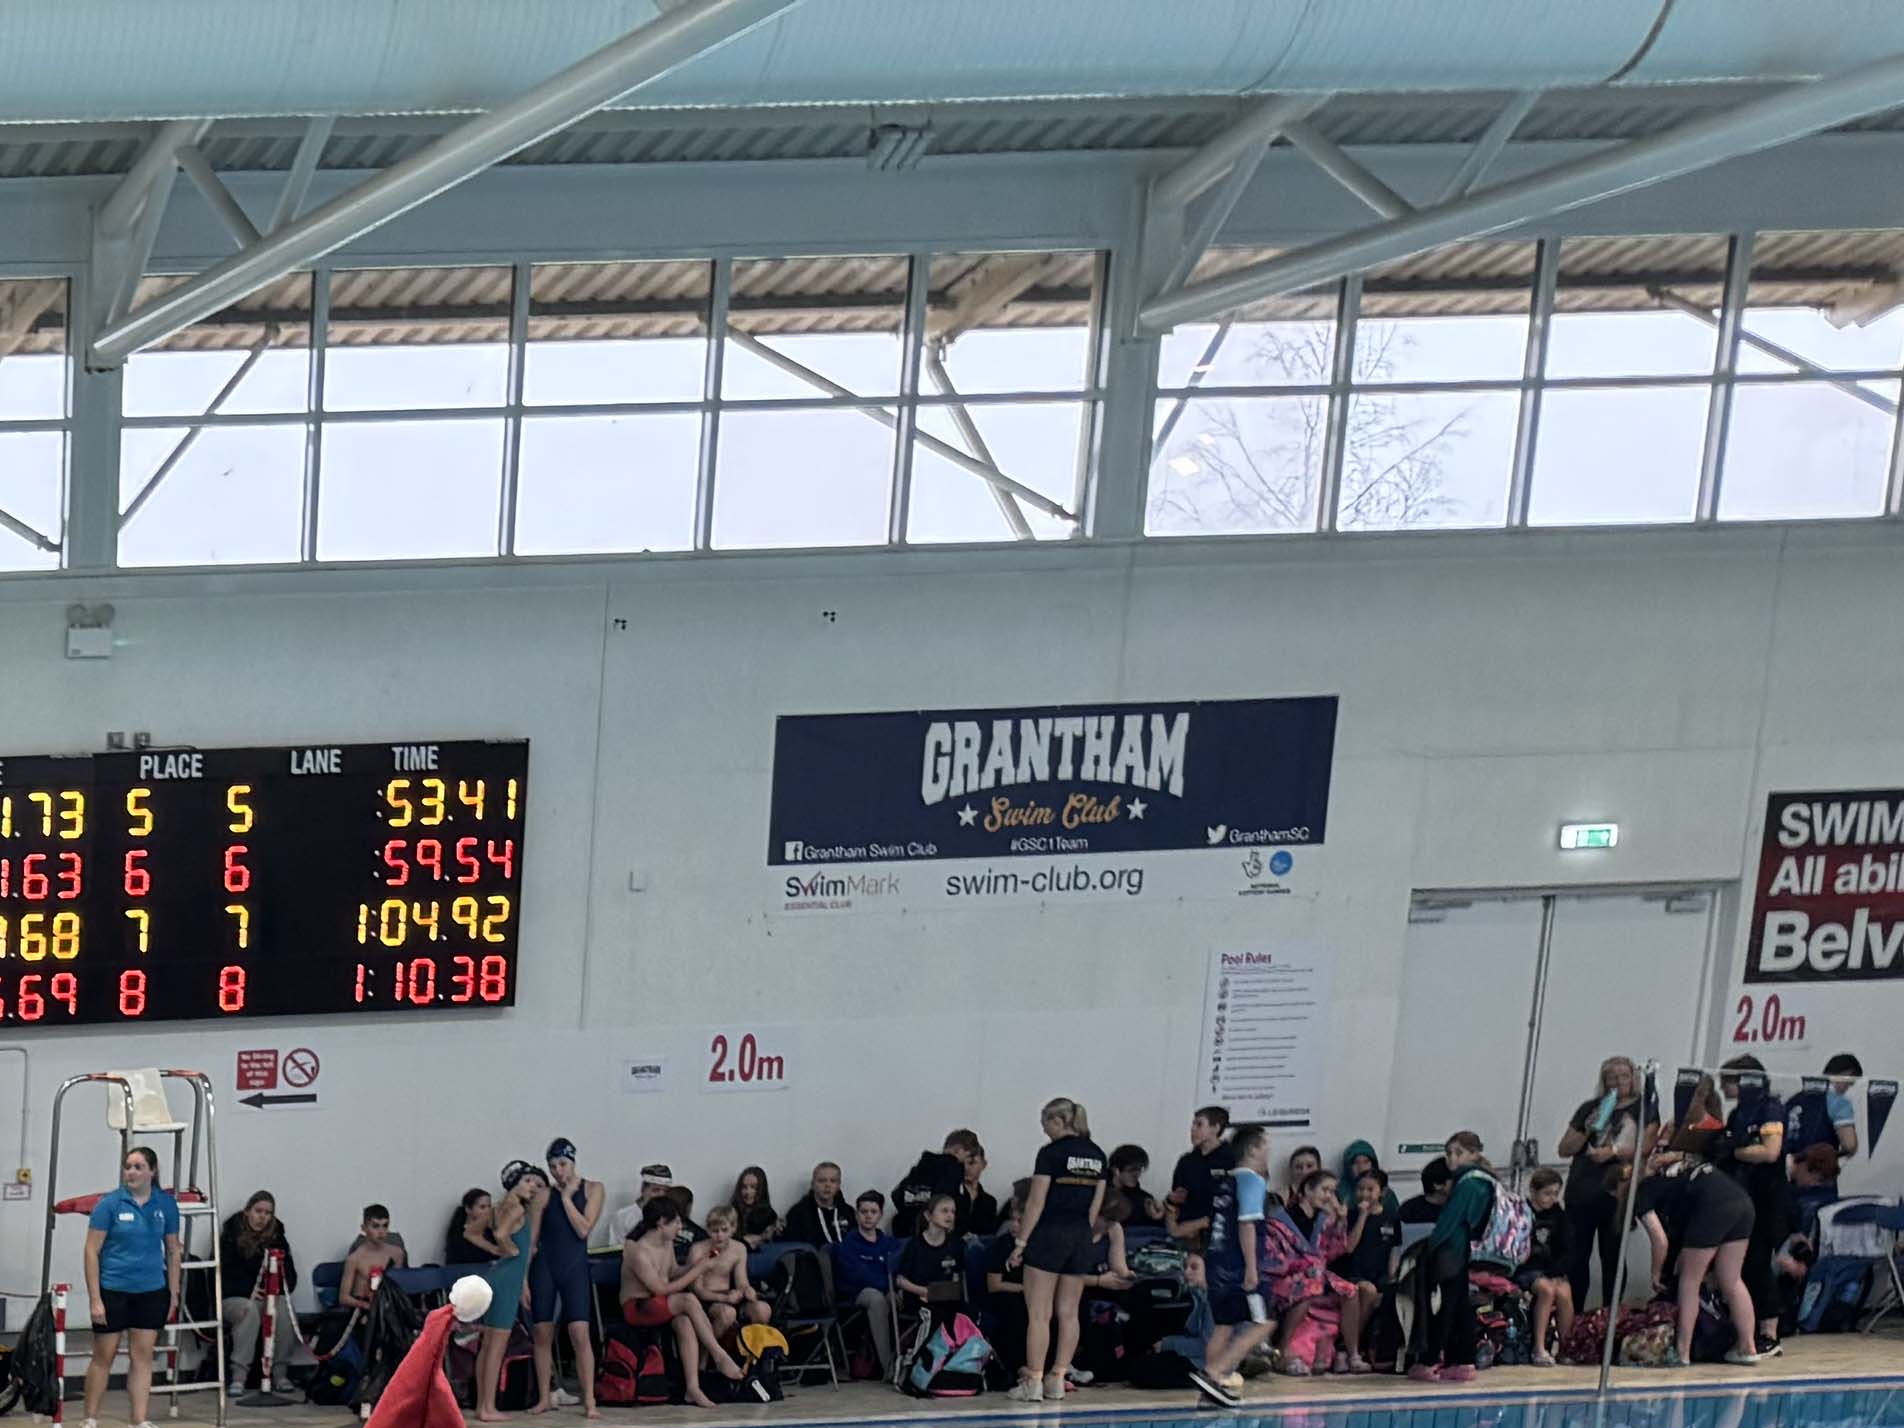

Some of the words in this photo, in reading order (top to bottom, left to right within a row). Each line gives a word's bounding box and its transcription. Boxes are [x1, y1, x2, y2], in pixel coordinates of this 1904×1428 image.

[140, 754, 203, 779] PLACE
[291, 749, 342, 774] LANE
[393, 745, 439, 771] TIME
[921, 712, 1190, 806] GRANTHAM
[127, 788, 153, 836] 5
[226, 784, 253, 833] 5
[983, 796, 1056, 833] Swim
[1062, 792, 1121, 830] Club
[1778, 800, 1904, 848] SWIM
[124, 850, 150, 895] 6
[224, 846, 250, 892] 6
[804, 844, 867, 860] Grantham
[868, 842, 905, 857] Swim
[907, 841, 938, 856] Club
[785, 871, 900, 897] SwimMark
[945, 864, 1144, 896] swim-club.org
[1768, 856, 1826, 896] All
[124, 909, 149, 953] 7
[225, 905, 249, 949] 7
[1759, 907, 1904, 972] Belv
[120, 969, 146, 1016] 8
[219, 965, 247, 1012] 8
[1733, 993, 1805, 1042] 2.0m
[708, 1033, 784, 1082] 2.0m
